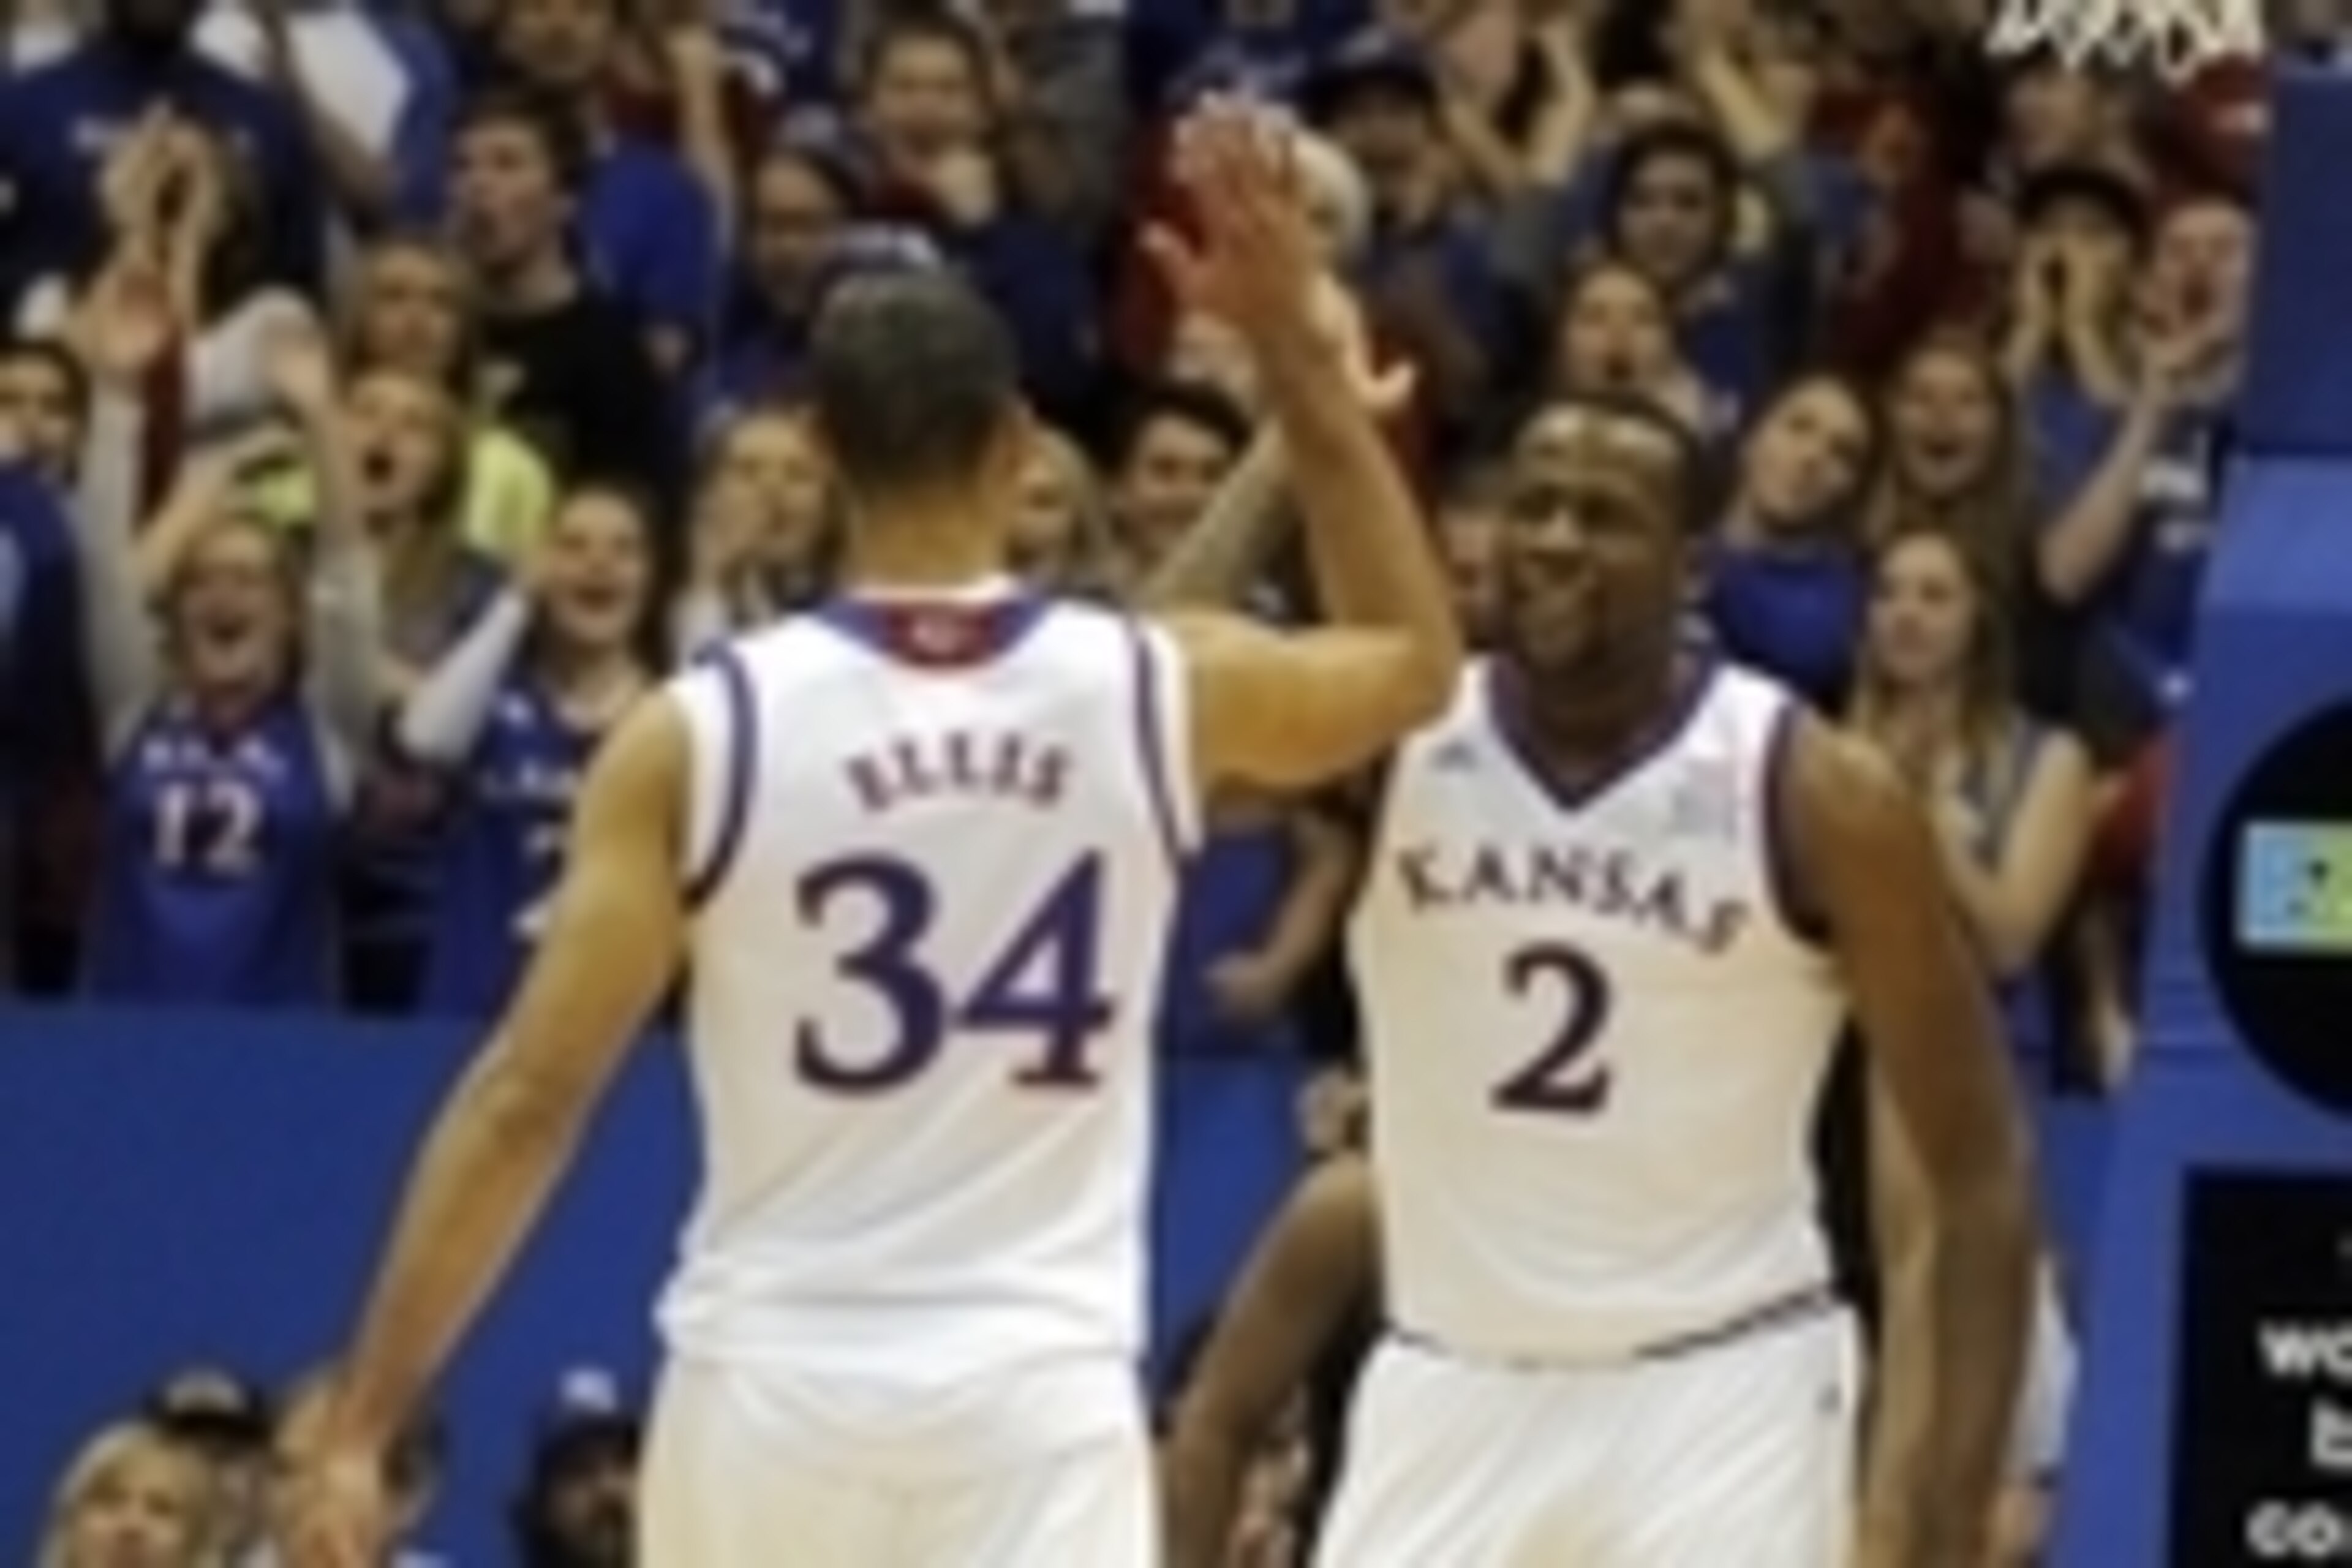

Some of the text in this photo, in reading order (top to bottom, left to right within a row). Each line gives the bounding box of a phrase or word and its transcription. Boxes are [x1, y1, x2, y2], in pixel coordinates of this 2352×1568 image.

[844, 729, 1076, 813] ELLIS
[153, 779, 262, 873] 12
[1398, 840, 1751, 957] KANSAS
[795, 853, 1117, 1095] 34
[1490, 940, 1612, 1117] 2
[2245, 1499, 2352, 1559] co
